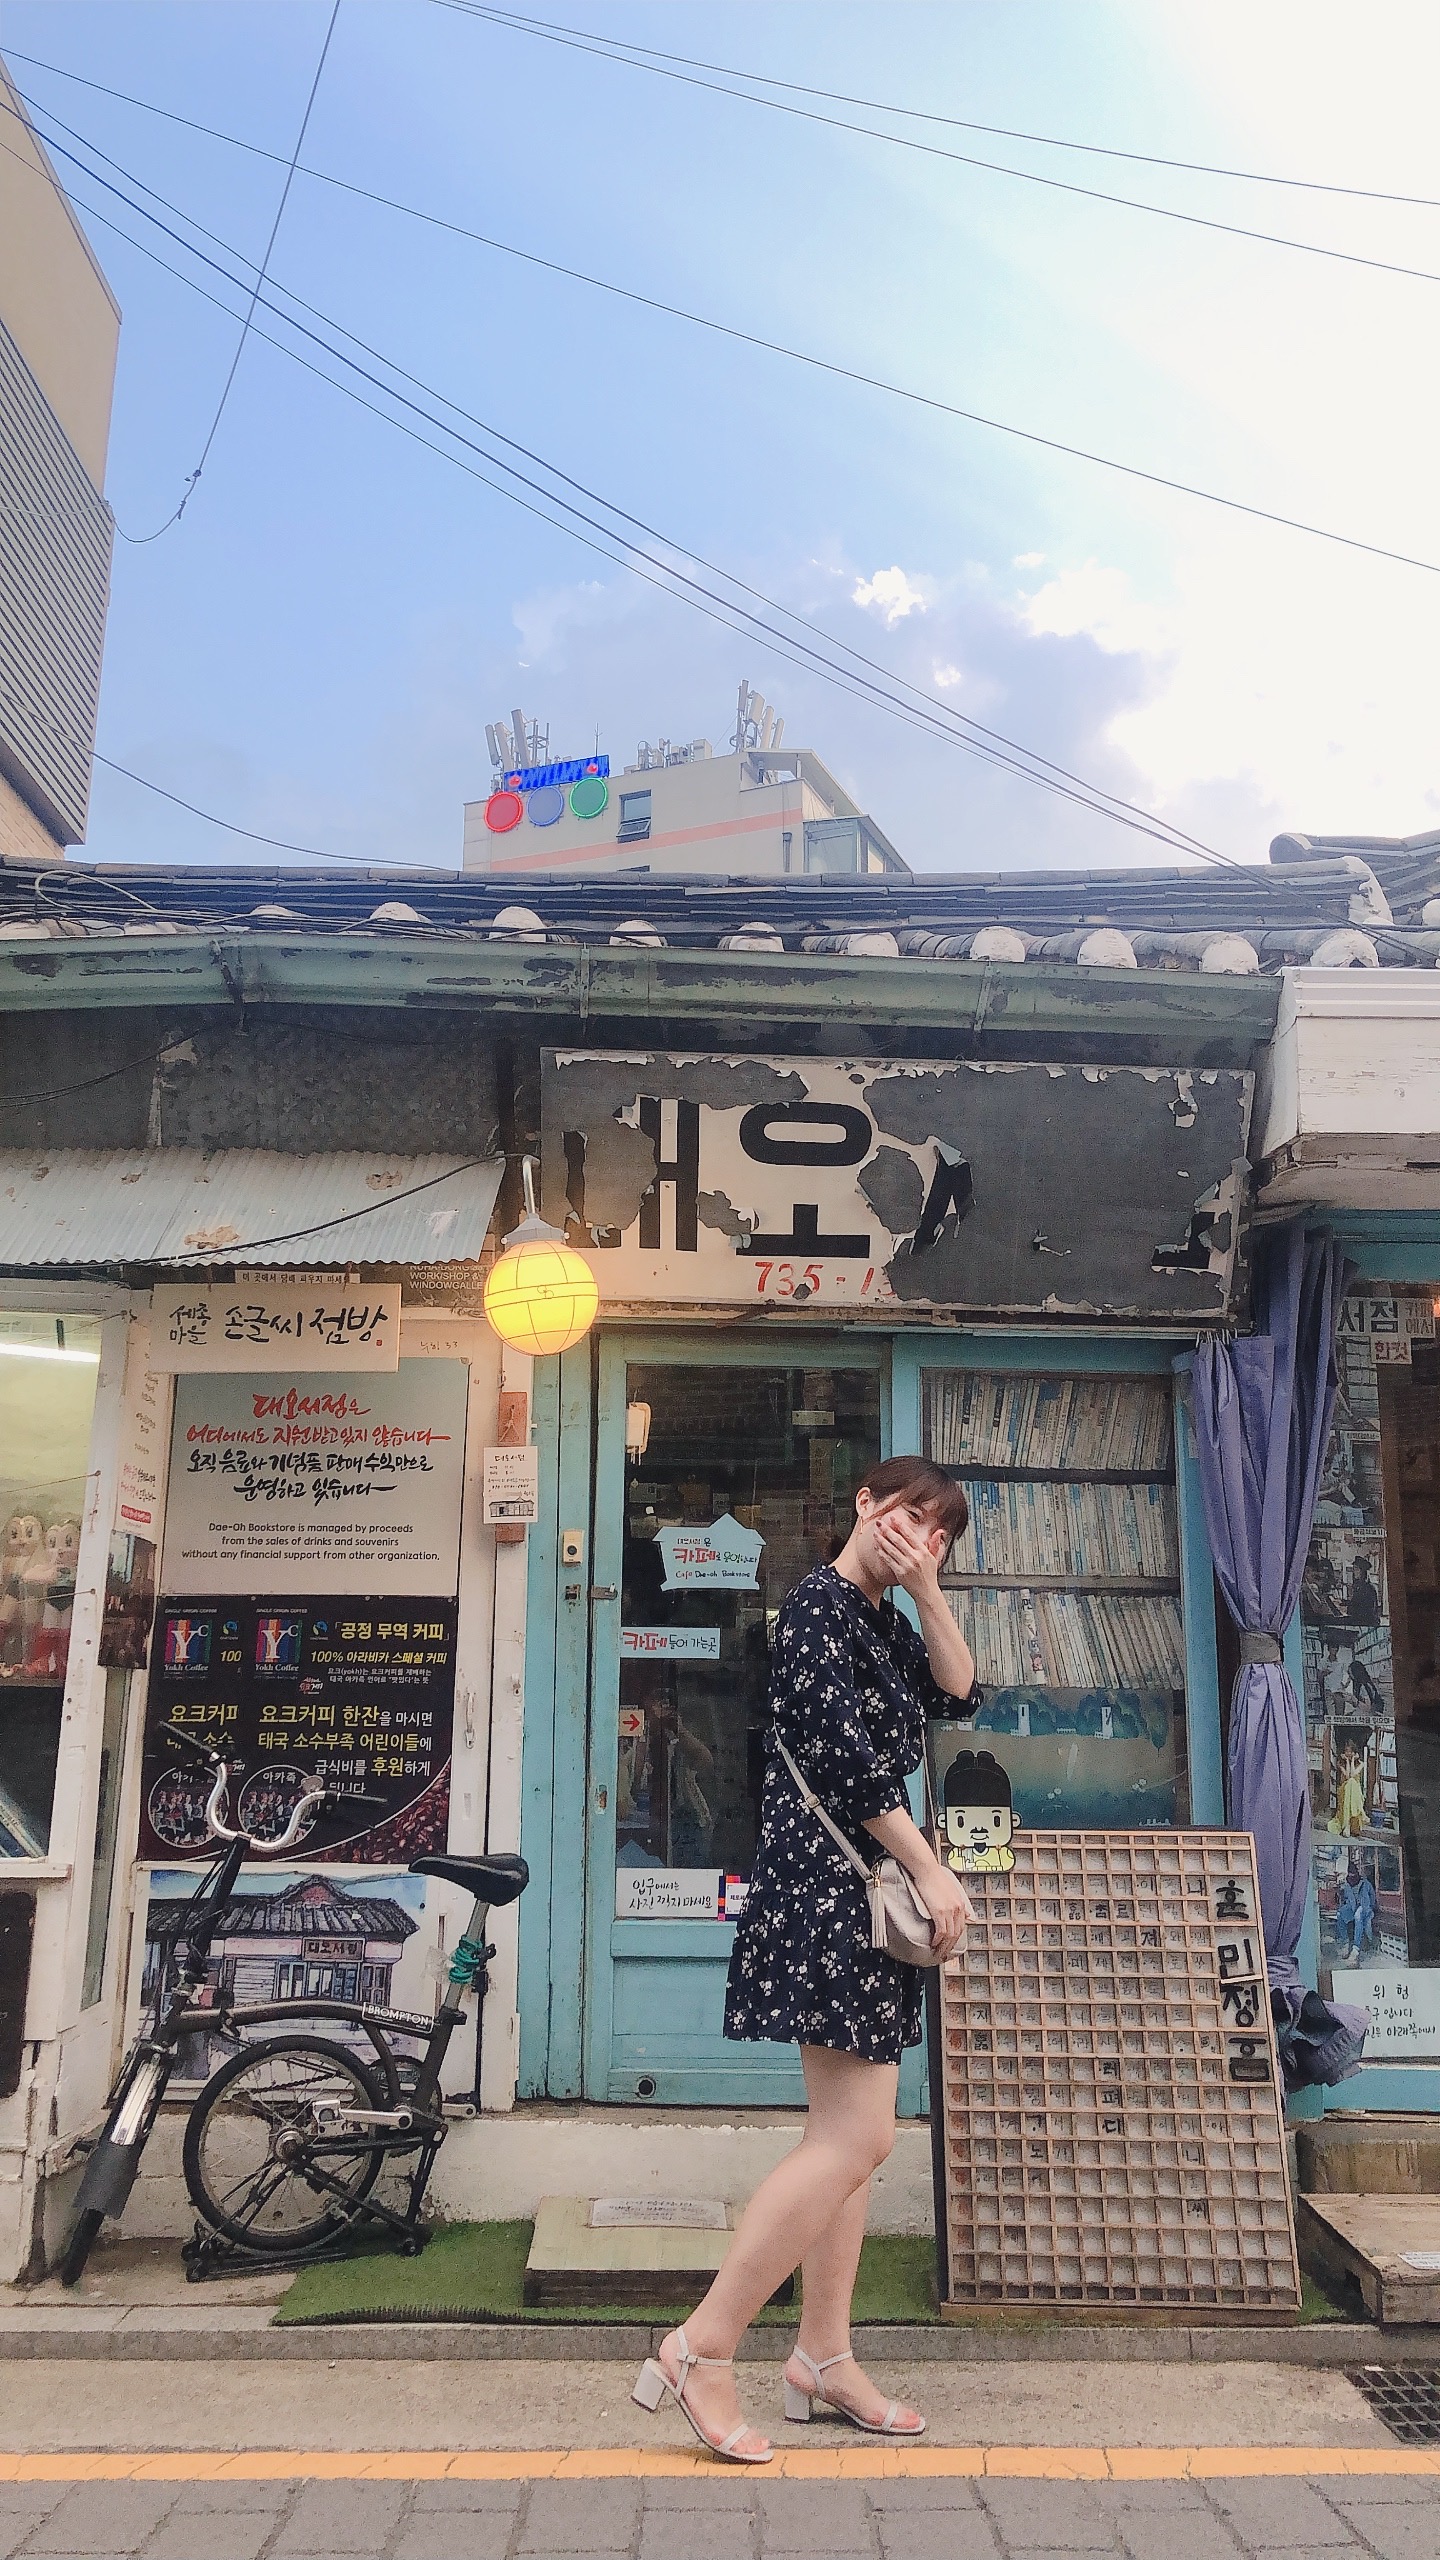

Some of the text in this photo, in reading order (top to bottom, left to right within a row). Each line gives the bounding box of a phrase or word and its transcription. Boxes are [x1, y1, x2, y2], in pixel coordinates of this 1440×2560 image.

[225, 1305, 303, 1343] 손글씨
[187, 1449, 217, 1473] 오직
[208, 1522, 414, 1535] Dae-Oh Bookstore is managed by proceeds
[221, 1536, 400, 1547] from the sales of drinks and souvenirs
[181, 1550, 219, 1560] without
[220, 1551, 238, 1562] any
[239, 1550, 283, 1560] financial
[283, 1550, 322, 1562] support
[322, 1550, 347, 1560] from
[348, 1551, 376, 1560] other
[377, 1623, 408, 1640] 무역
[622, 1631, 668, 1651] 카페
[311, 1651, 448, 1665] 100% 아라비카 스페셜 커피
[259, 1704, 433, 1727] 요크커피 한잔을 마시면
[258, 1732, 432, 1752] 태국 소수부족 어린이들에
[314, 1757, 431, 1777] 급식비를 후원하게
[262, 1771, 297, 1784] 아카족
[628, 1897, 654, 1910] 사진
[367, 2004, 430, 2026] BROMPTON
